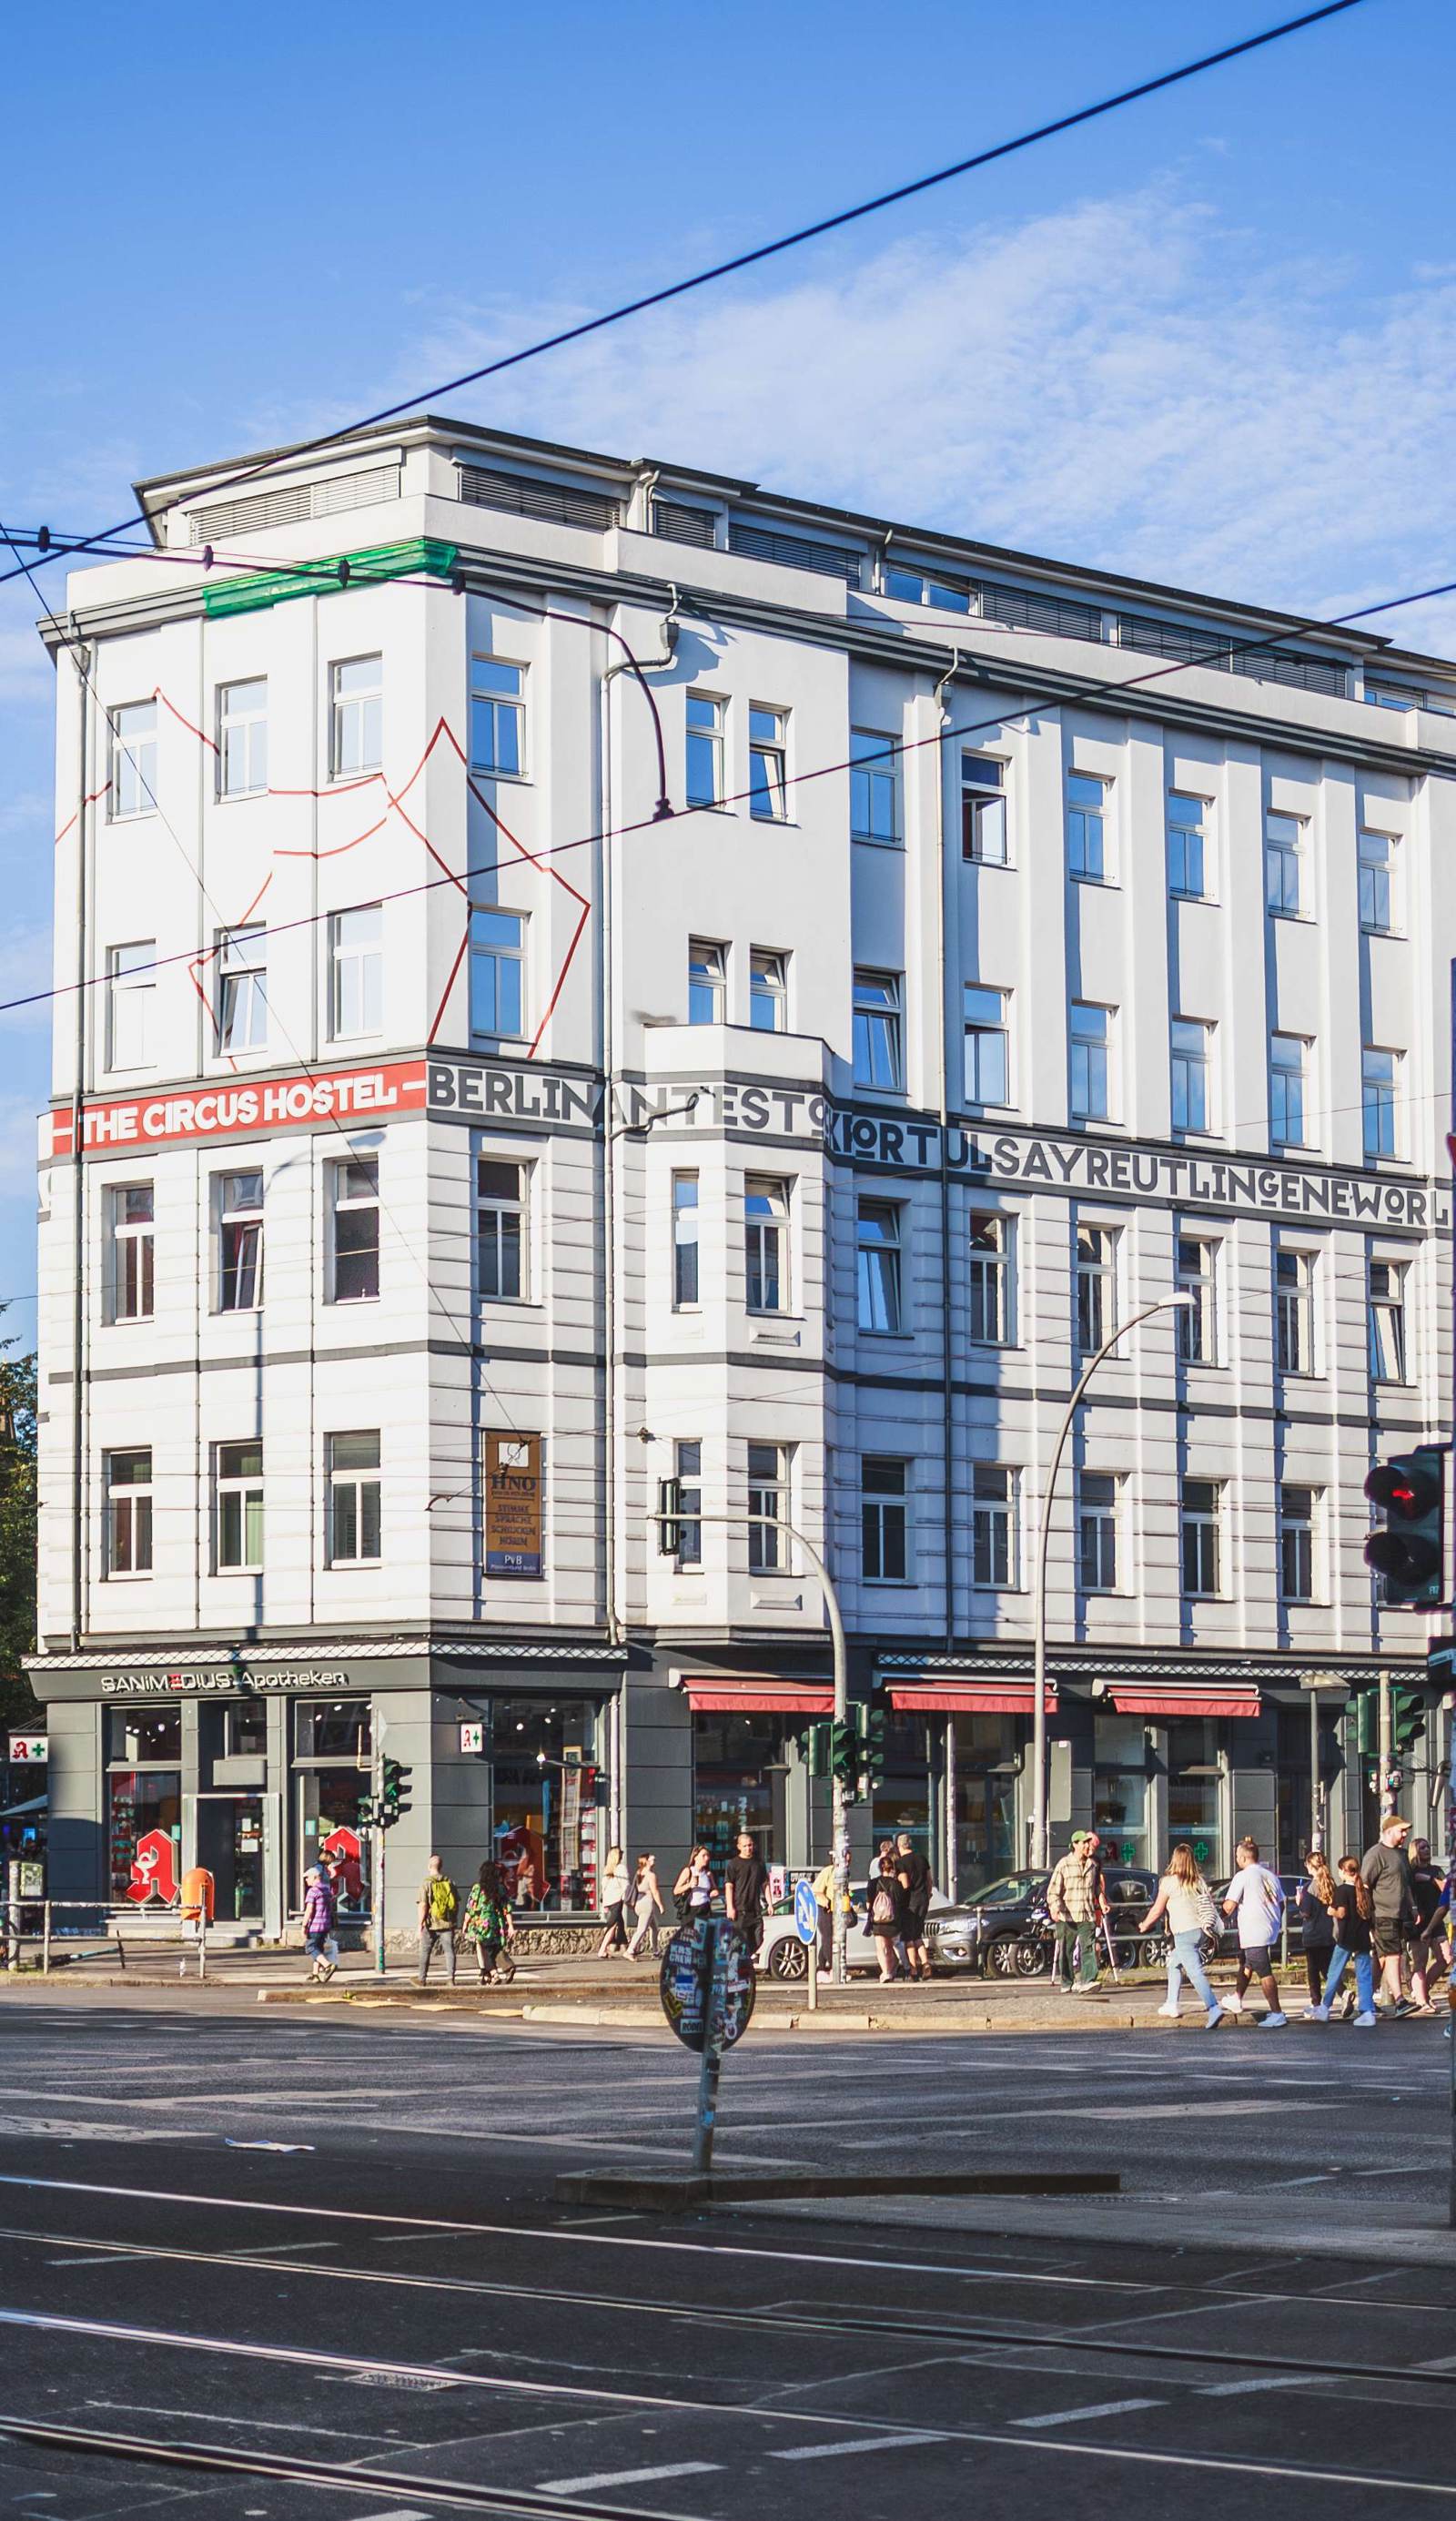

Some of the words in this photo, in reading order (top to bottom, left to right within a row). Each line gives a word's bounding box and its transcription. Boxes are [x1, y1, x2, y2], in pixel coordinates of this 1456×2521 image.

[80, 1107, 138, 1144] THE
[142, 1090, 258, 1138] CIRCUS
[264, 1073, 398, 1121] HOSTEL
[428, 1064, 603, 1122] BERLIN
